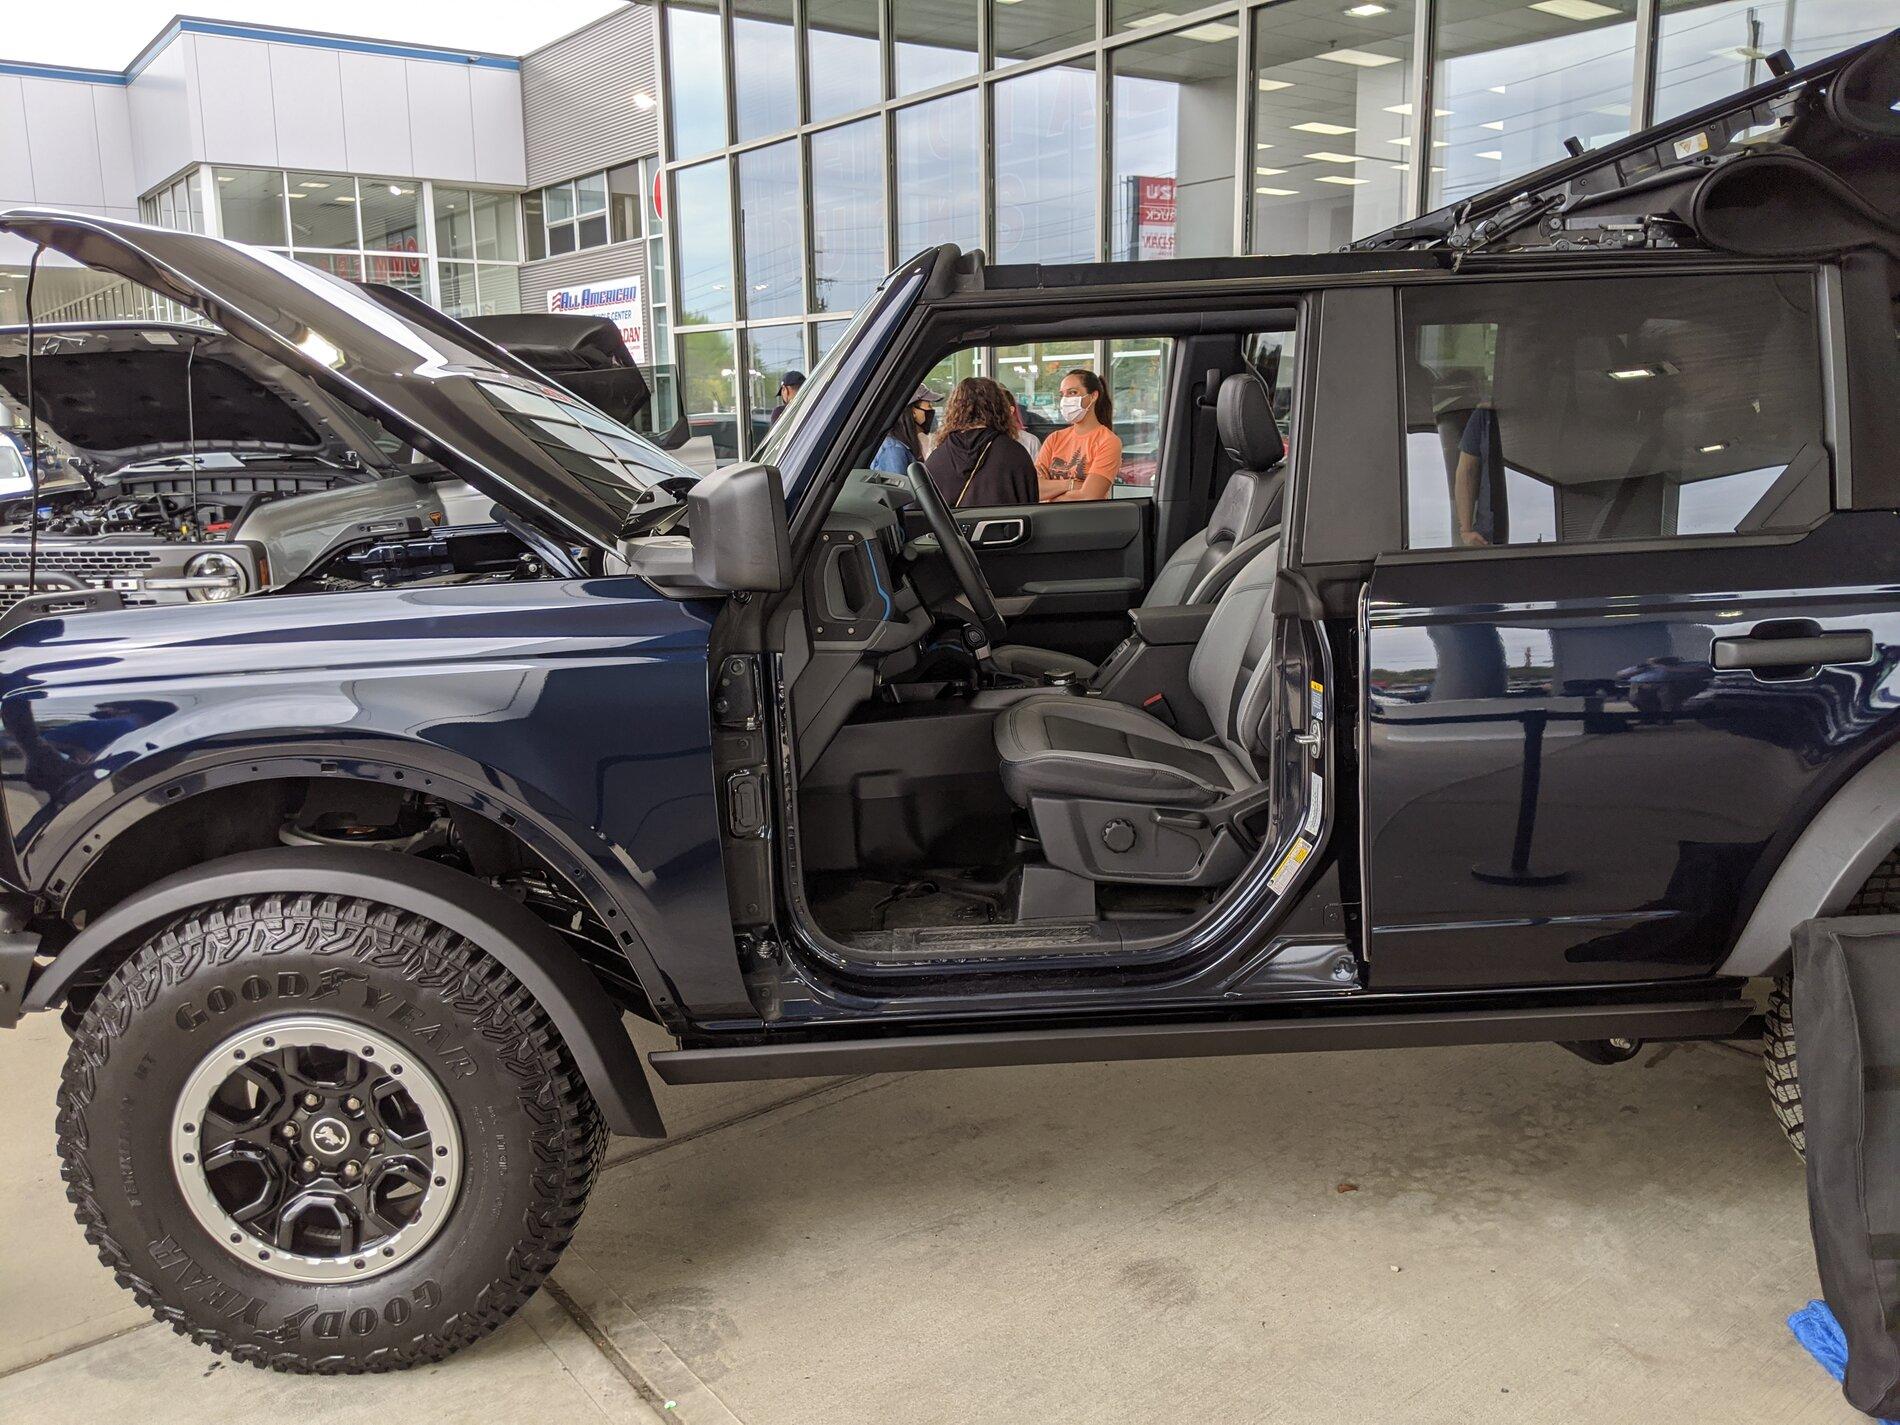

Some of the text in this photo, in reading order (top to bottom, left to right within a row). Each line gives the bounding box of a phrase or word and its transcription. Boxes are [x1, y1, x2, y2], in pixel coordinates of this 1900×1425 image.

[560, 286, 637, 310] ALL AMERICAN
[611, 310, 632, 320] CENTER
